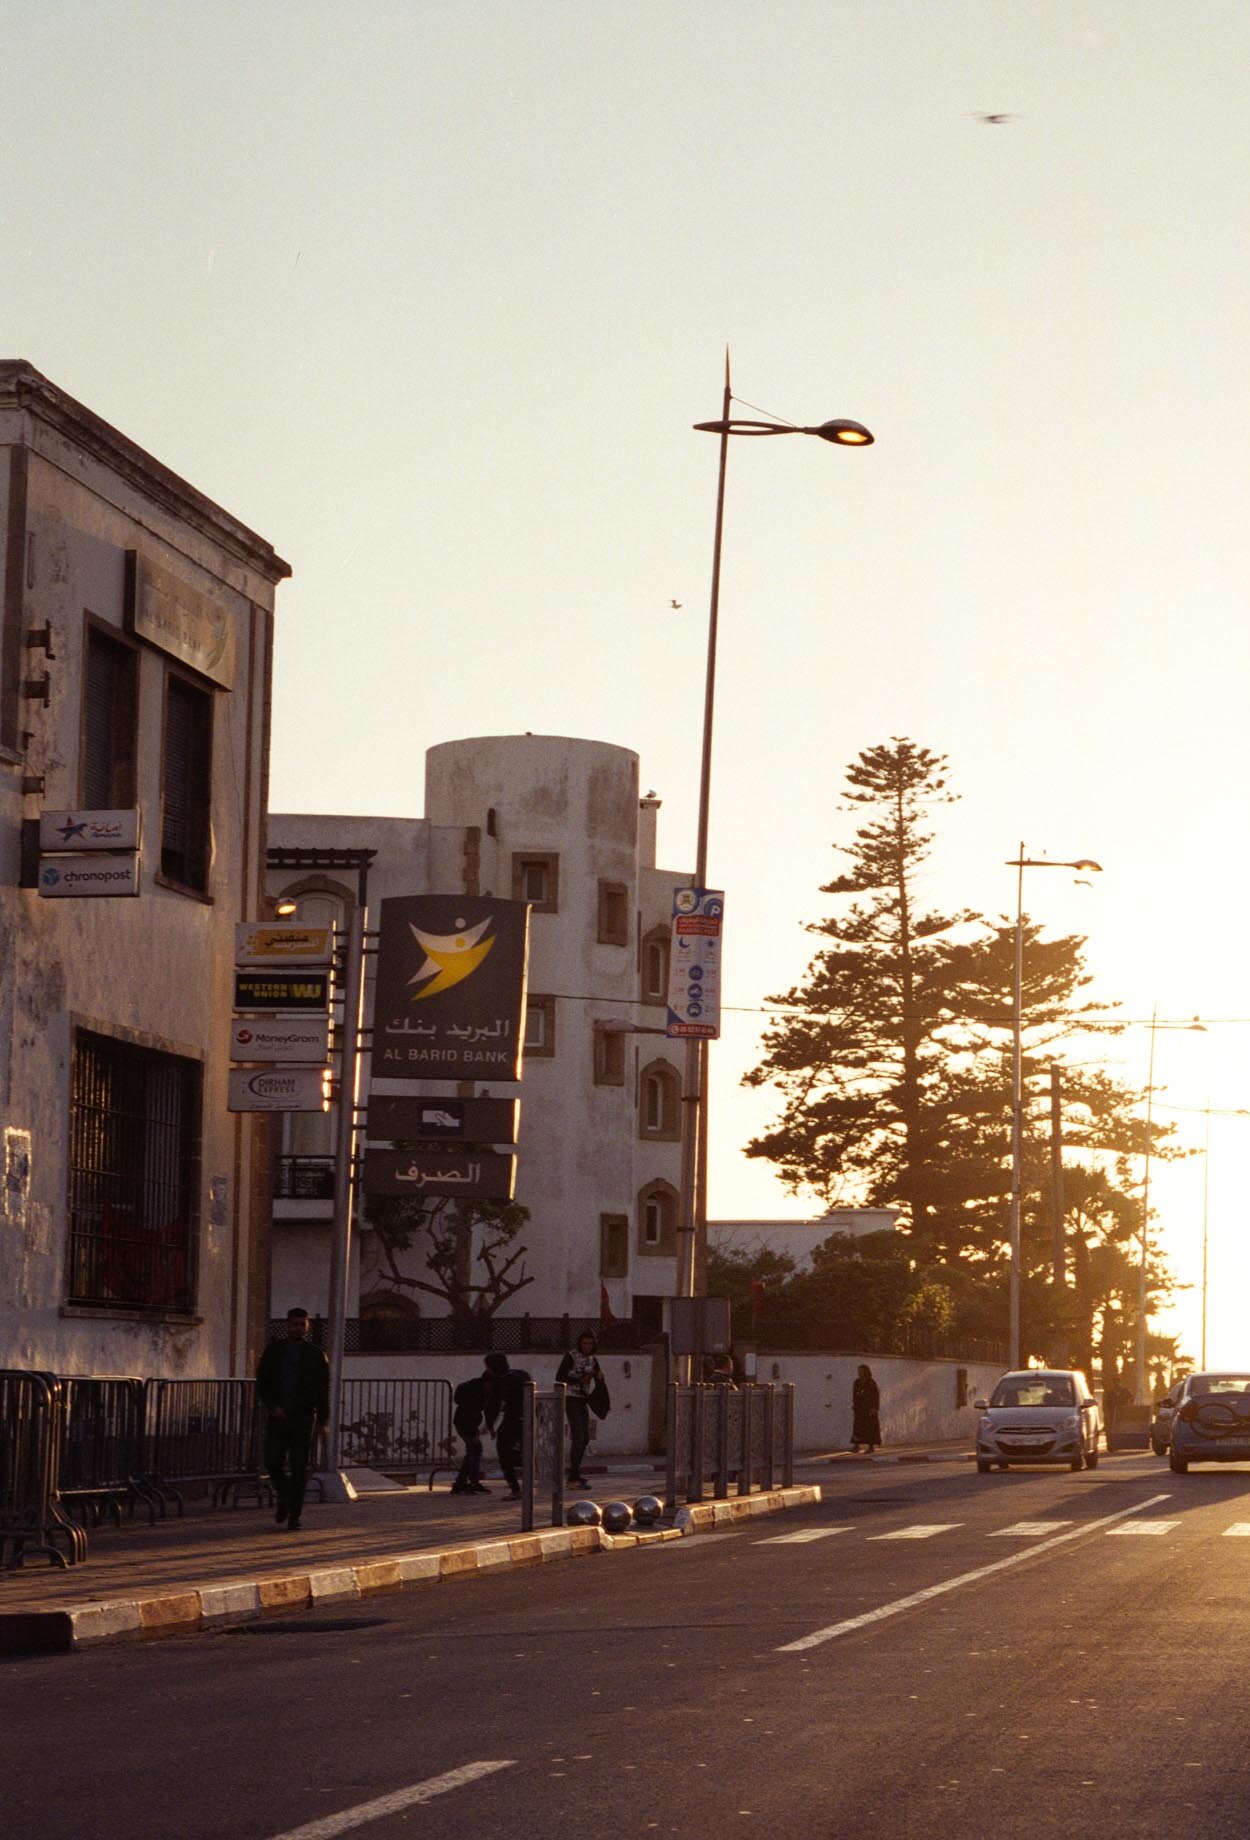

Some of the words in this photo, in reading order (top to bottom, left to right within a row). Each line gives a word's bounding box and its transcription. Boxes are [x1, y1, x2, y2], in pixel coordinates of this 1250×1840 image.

[64, 868, 132, 883] chronopost
[239, 983, 288, 991] WESTERN
[254, 990, 288, 998] UNION
[385, 1017, 437, 1040] بنك
[446, 1018, 510, 1042] البريد
[255, 1033, 320, 1044] MoneyGram
[384, 1048, 402, 1060] AL
[408, 1049, 458, 1062] BARID
[463, 1050, 508, 1063] BANK
[258, 1078, 296, 1087] DIRHAM
[394, 1160, 481, 1188] الصرف
